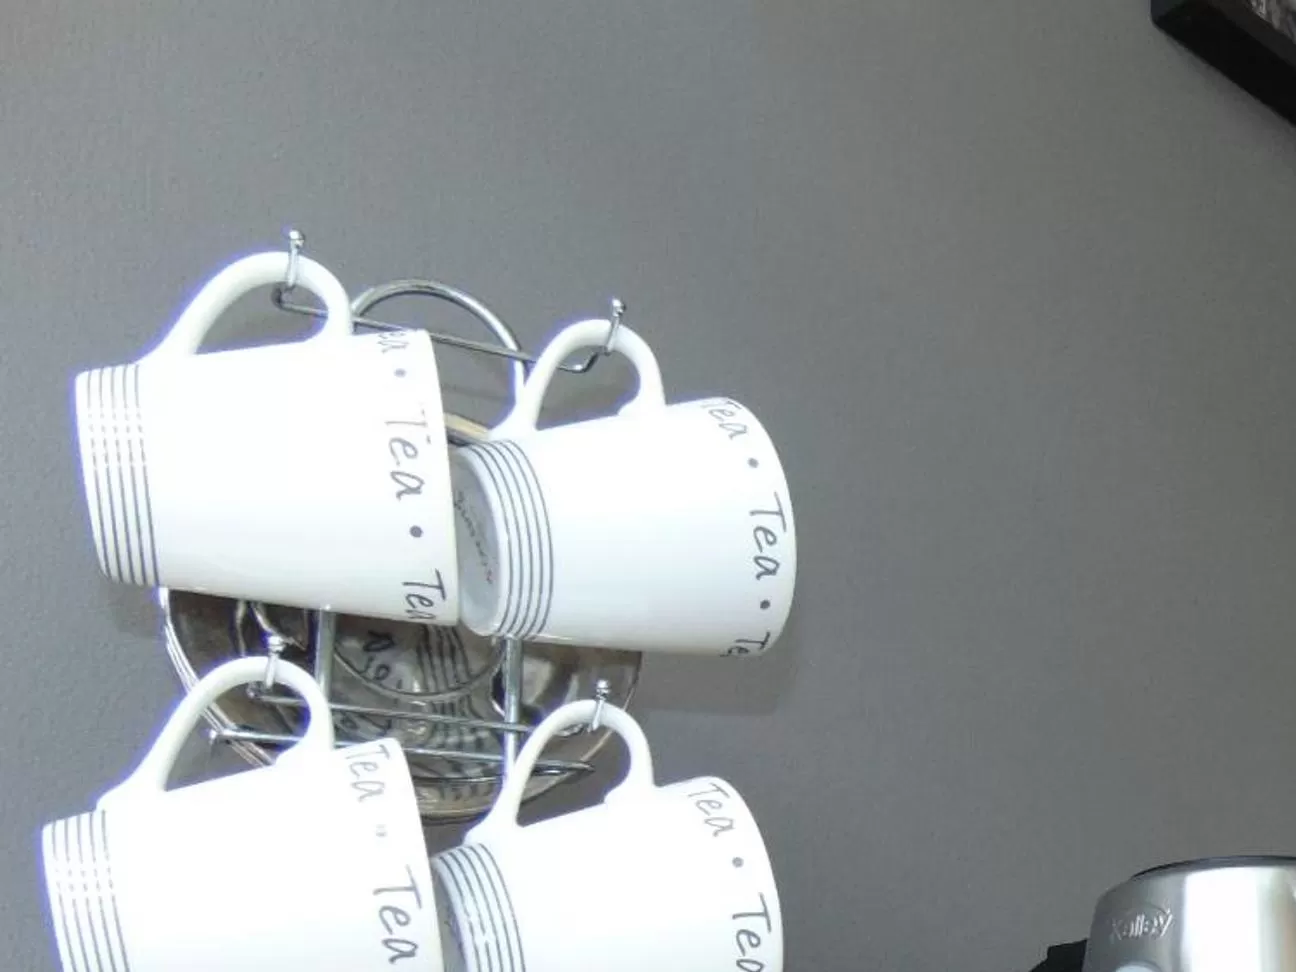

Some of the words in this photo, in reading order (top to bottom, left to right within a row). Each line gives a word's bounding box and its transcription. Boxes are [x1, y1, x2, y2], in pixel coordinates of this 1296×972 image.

[384, 401, 433, 502] Tea
[700, 400, 749, 441] Tea
[748, 490, 788, 582] Tea
[720, 631, 771, 657] Te
[687, 781, 736, 838] Tea
[345, 743, 390, 803] Tea
[372, 863, 423, 965] Tea
